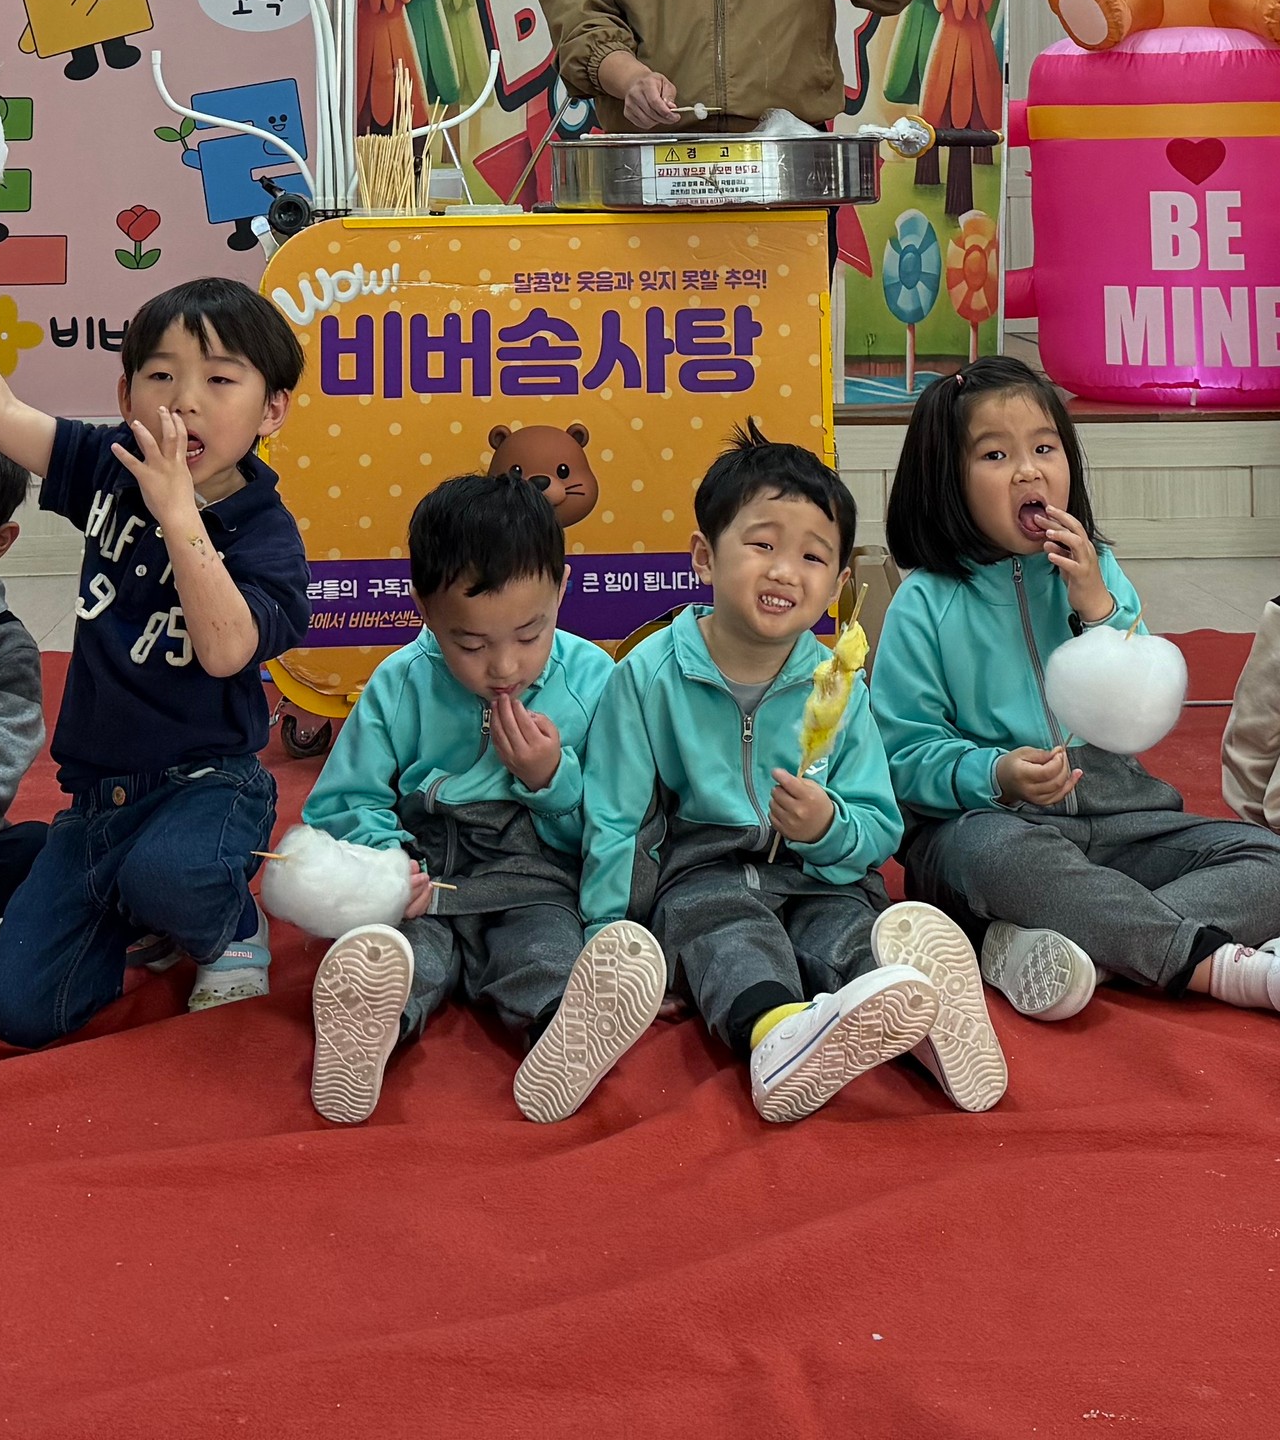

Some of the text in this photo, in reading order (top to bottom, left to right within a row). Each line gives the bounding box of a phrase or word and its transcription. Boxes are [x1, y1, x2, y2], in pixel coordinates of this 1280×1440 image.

[1149, 190, 1245, 271] BE
[513, 268, 768, 294] 달콤한 웃음과 잊지 못할 추억!
[320, 304, 763, 398] 비버솜사탕
[582, 571, 700, 592] 큰 힘이 됩니다!
